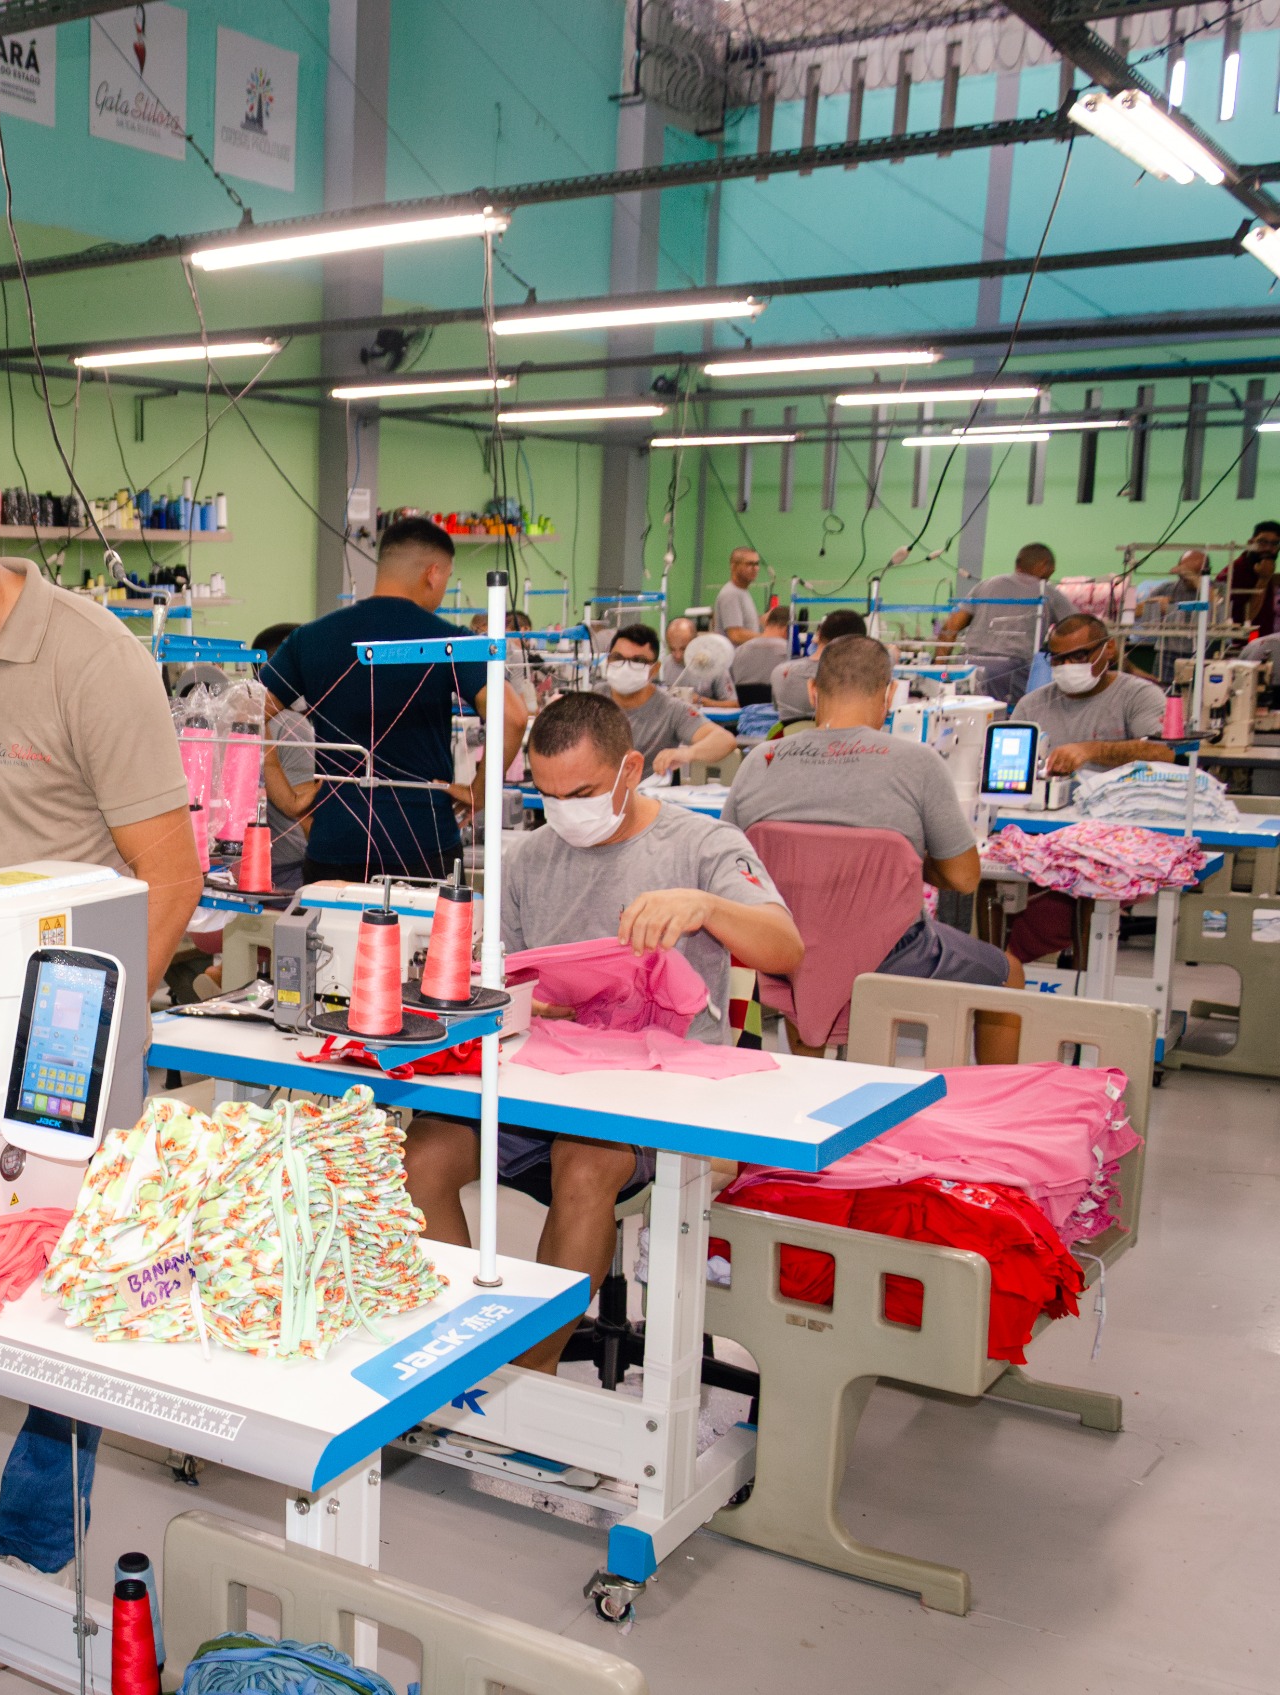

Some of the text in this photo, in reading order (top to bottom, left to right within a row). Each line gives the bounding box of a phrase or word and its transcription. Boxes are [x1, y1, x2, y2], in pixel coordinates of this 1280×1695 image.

[95, 80, 130, 117] Gata
[8, 744, 52, 763] Stilosa
[777, 740, 889, 760] Gata Stilosa
[460, 1303, 515, 1332] 杰克
